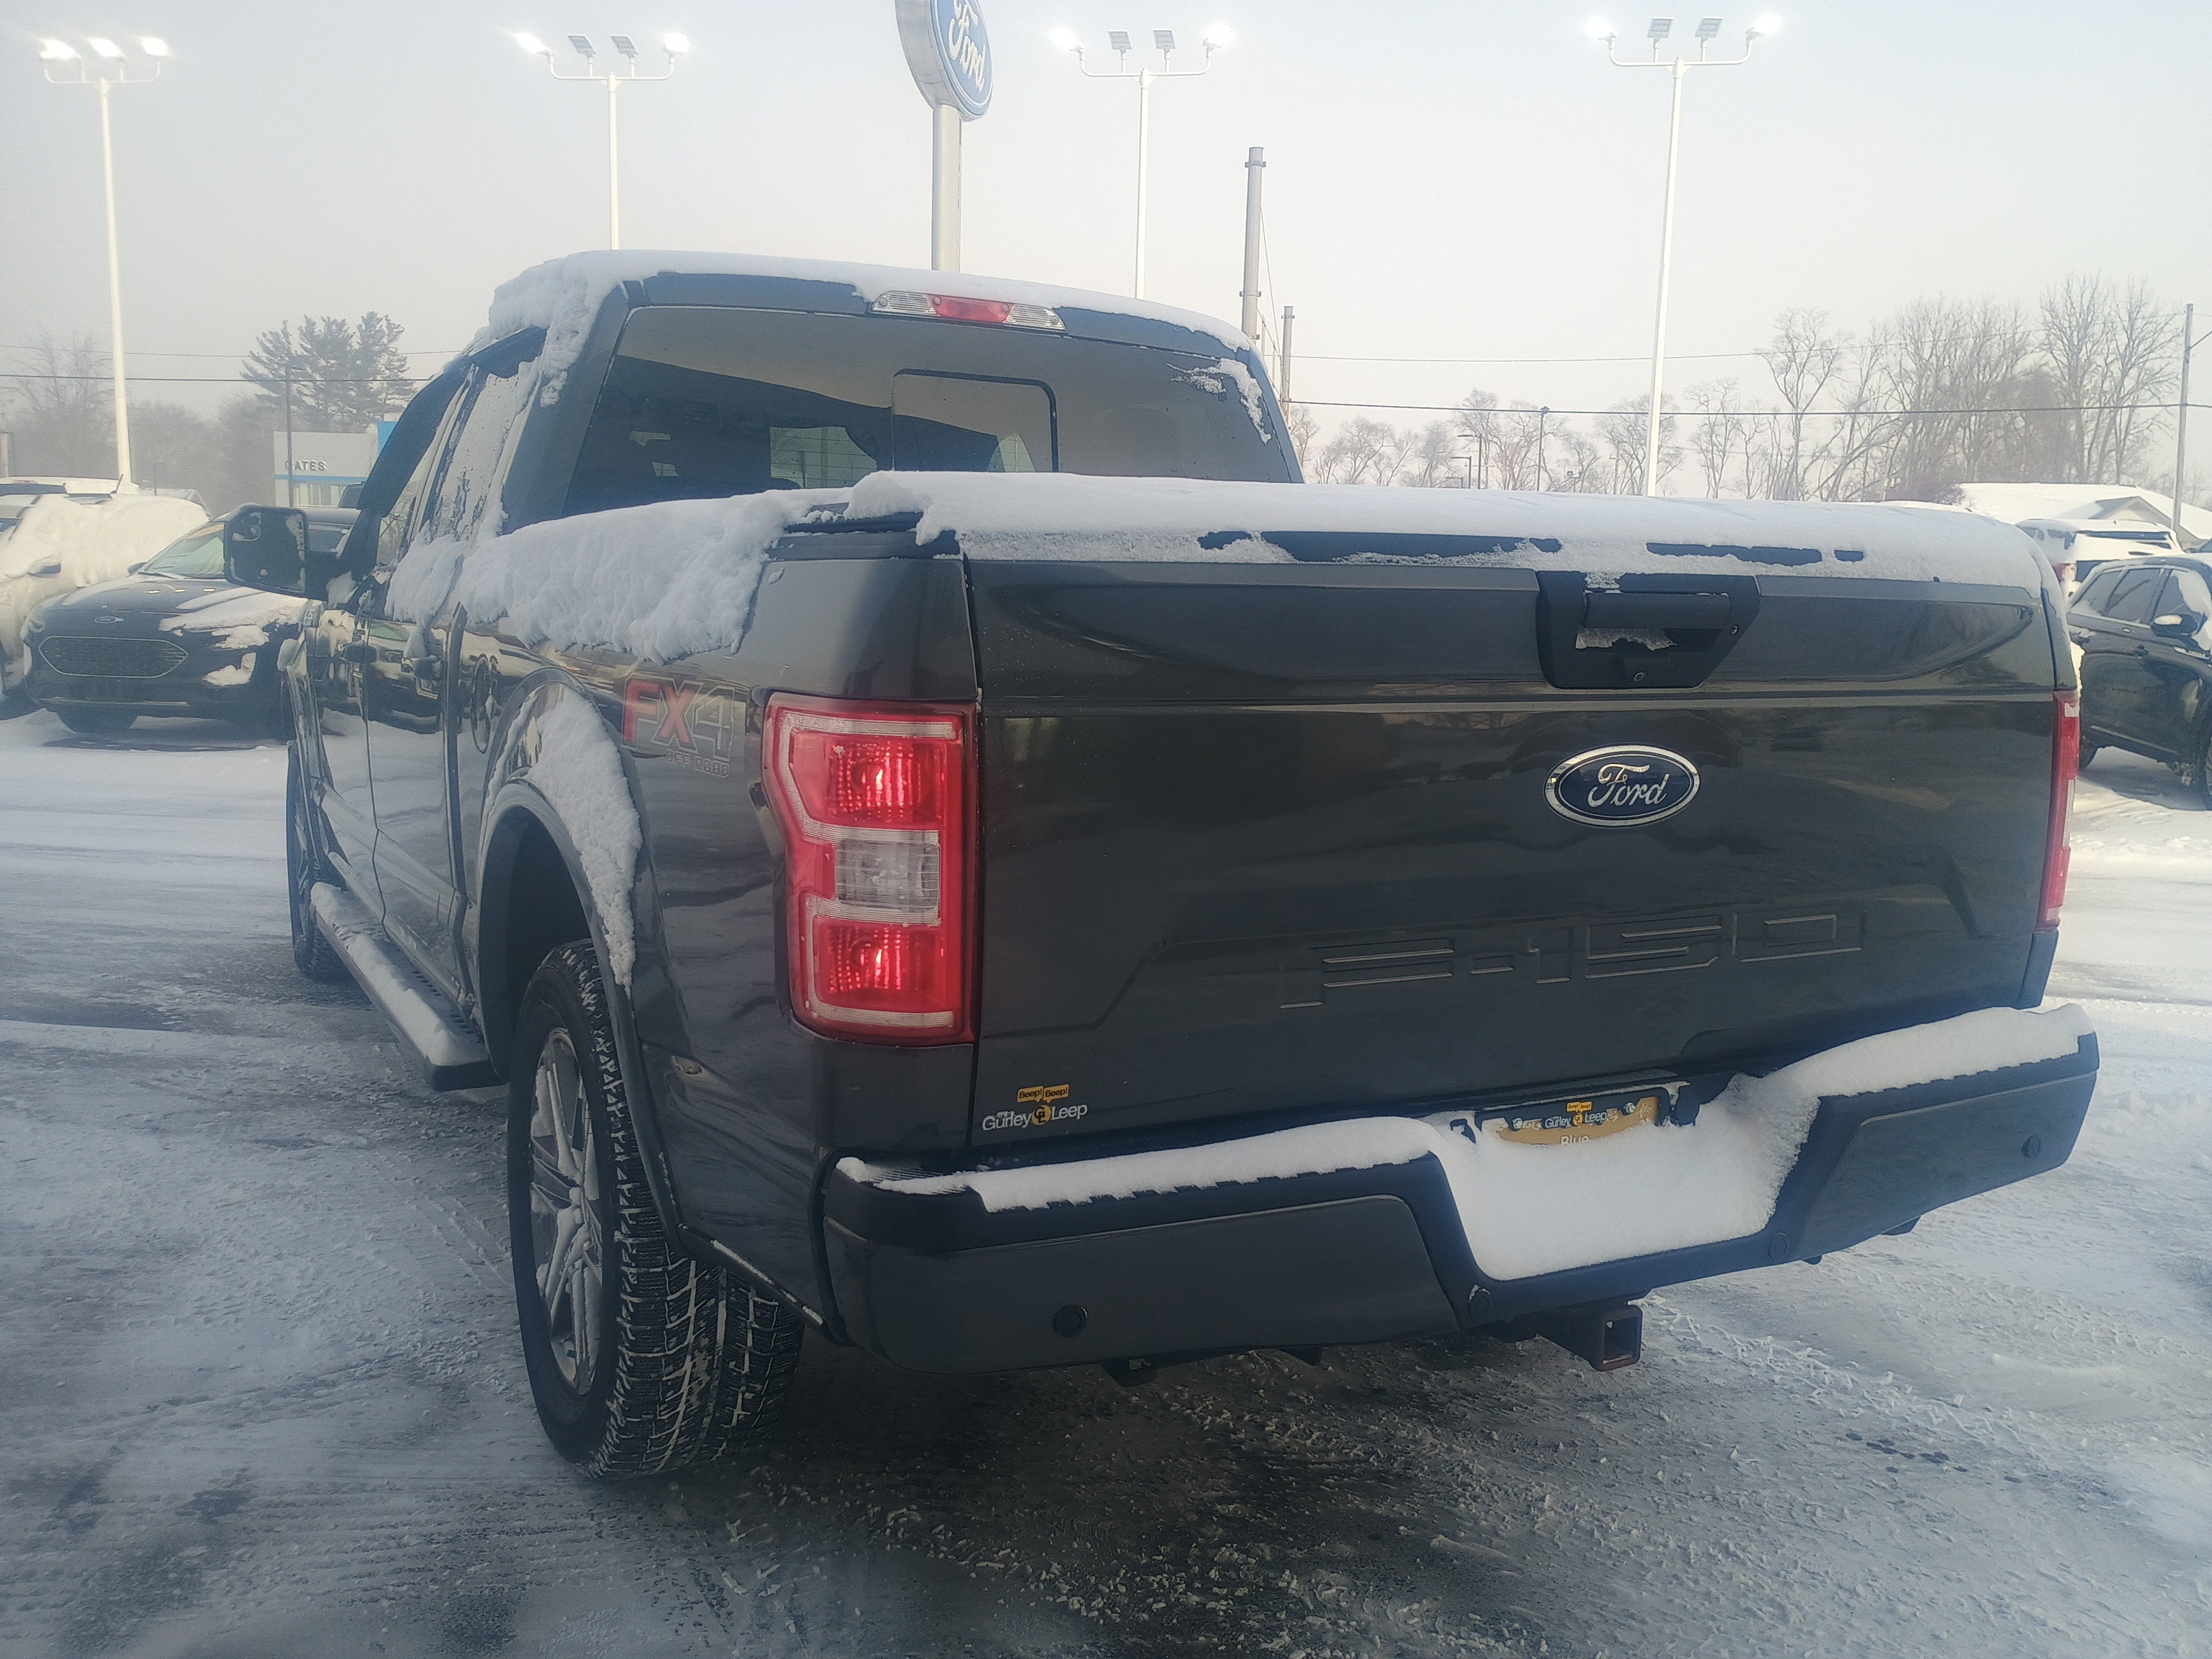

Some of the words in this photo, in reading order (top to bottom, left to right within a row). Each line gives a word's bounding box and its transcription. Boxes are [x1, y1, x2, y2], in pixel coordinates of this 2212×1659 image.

[948, 0, 987, 93] Ford
[622, 673, 734, 760] FX4
[666, 749, 691, 767] OFF
[694, 757, 730, 778] ROAD
[1587, 763, 1670, 807] Ford
[1019, 1088, 1043, 1099] Beep!
[1045, 1087, 1068, 1097] Beep!
[982, 1110, 1032, 1131] Gurley
[1051, 1104, 1088, 1121] Leep
[1545, 1116, 1571, 1128] Gurley
[1584, 1112, 1608, 1124] Leep
